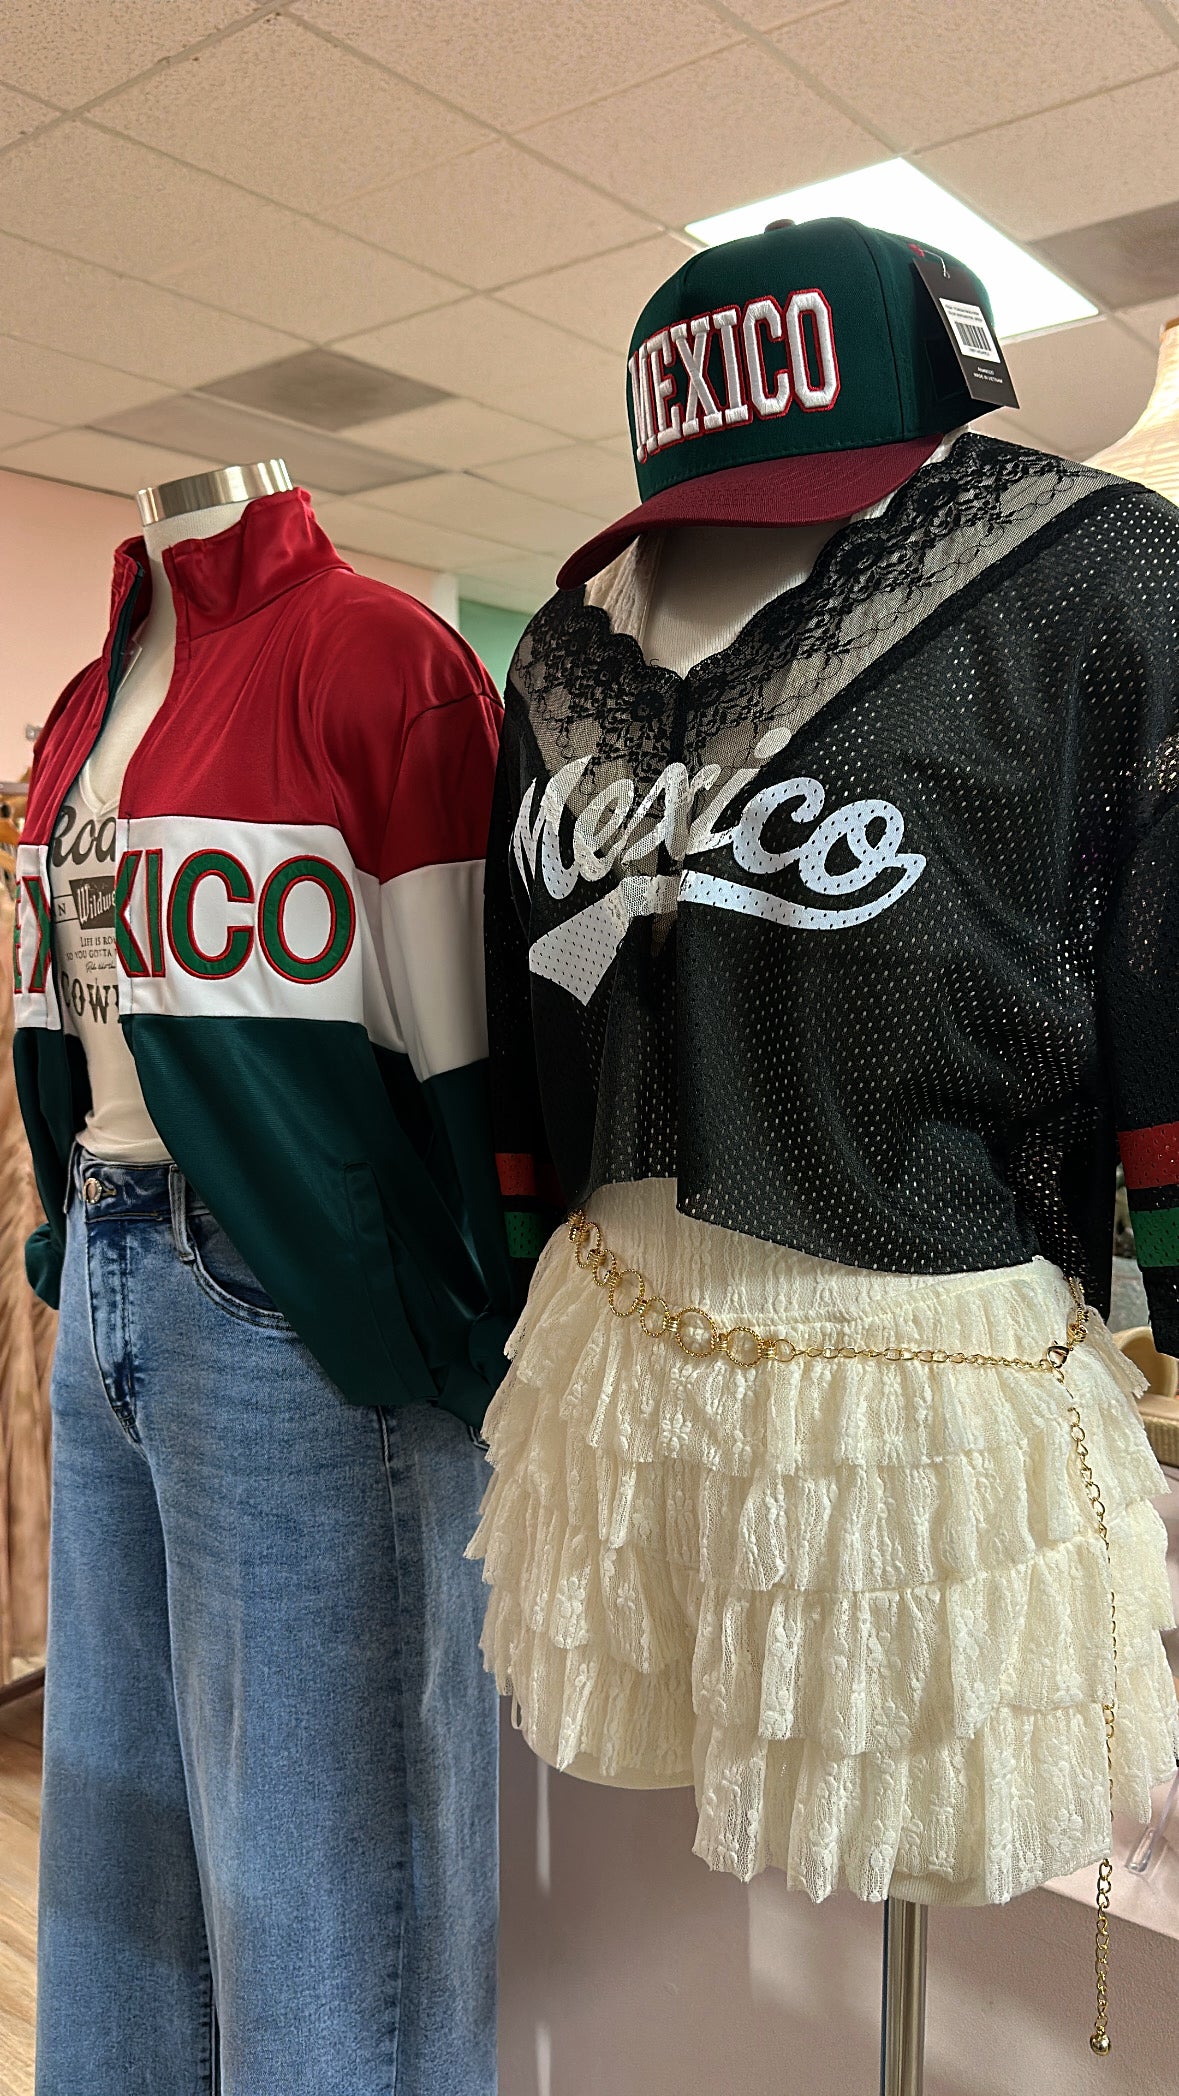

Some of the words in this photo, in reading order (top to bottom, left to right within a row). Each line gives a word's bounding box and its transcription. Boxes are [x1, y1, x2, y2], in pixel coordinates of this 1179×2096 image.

[628, 288, 841, 464] MEXICO
[509, 727, 927, 930] Mexico
[75, 949, 87, 959] YOU
[88, 948, 113, 958] GOTTA
[80, 936, 93, 947] LIFE
